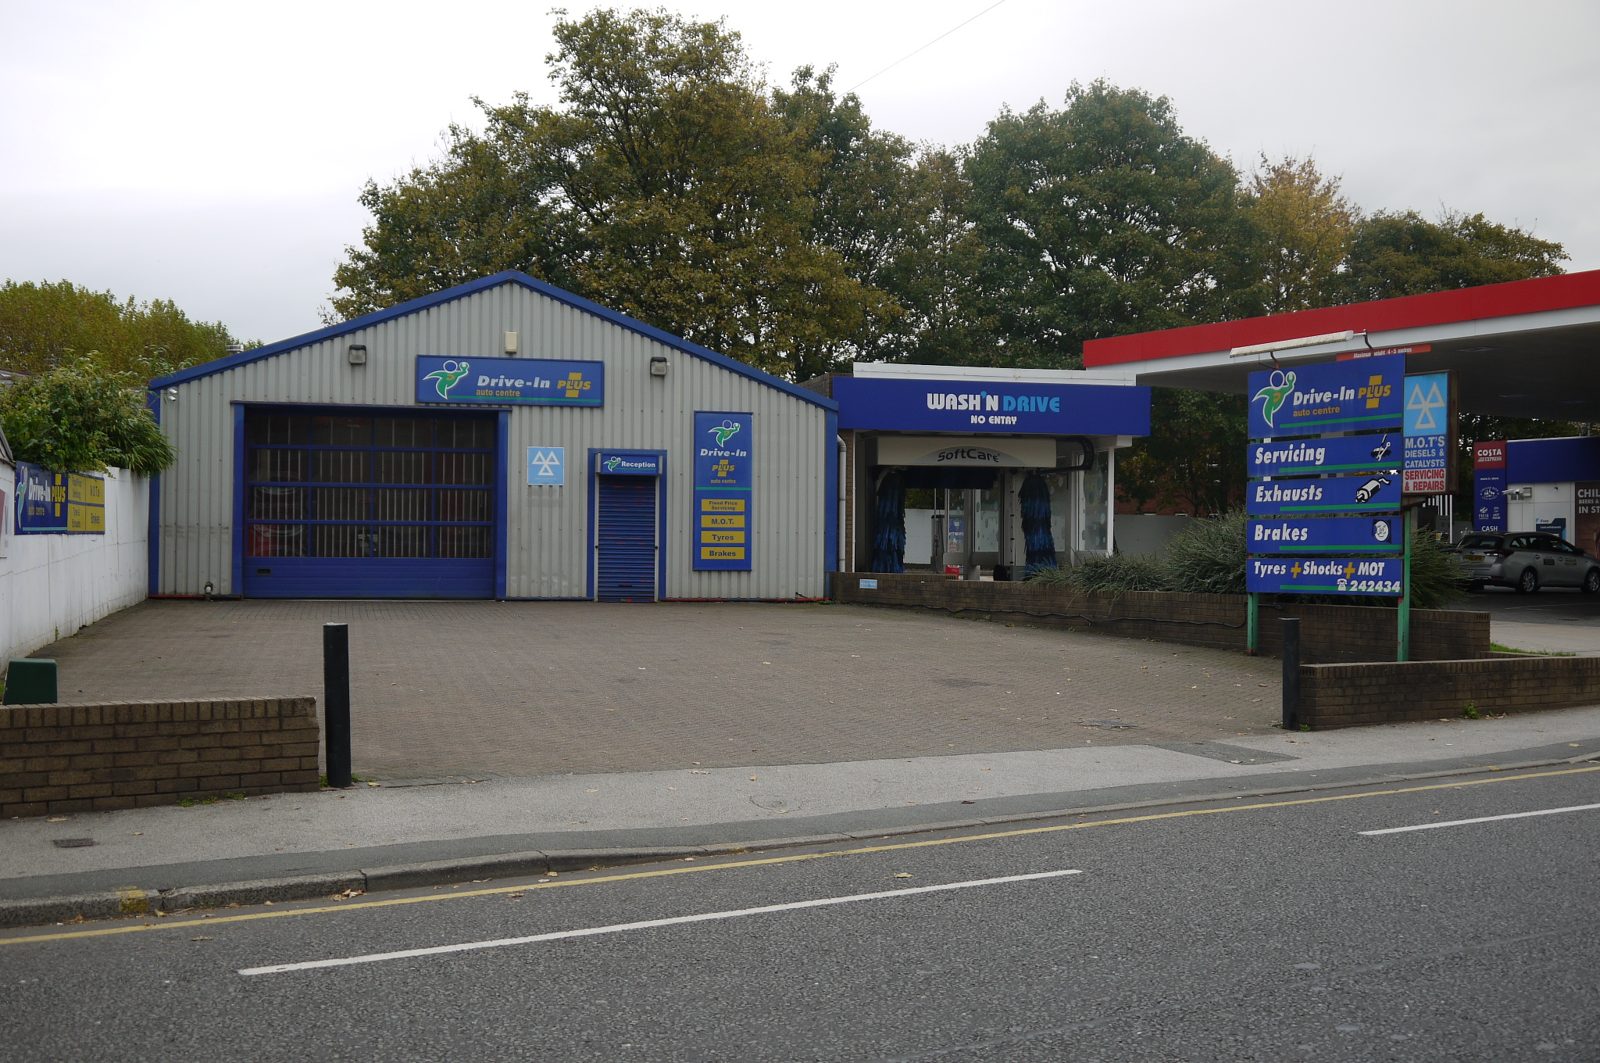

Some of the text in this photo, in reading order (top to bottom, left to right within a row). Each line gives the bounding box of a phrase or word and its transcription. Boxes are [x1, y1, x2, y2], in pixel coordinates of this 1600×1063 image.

[477, 375, 592, 391] Drive-In PLUS
[476, 388, 520, 397] auto centre
[1293, 384, 1391, 406] Drive-In PLUS
[926, 390, 1060, 413] WASH'N DRIVE
[1293, 405, 1340, 418] auto centre
[970, 414, 1018, 426] NO ENTRY
[1404, 436, 1445, 449] M.O.T'S
[700, 448, 747, 457] Drive-In
[1255, 443, 1326, 465] Servicing
[1404, 448, 1444, 458] DIESELS &
[1477, 448, 1502, 457] COSTA
[621, 460, 656, 469] Reception
[1404, 459, 1445, 468] CATALYSTS
[1404, 469, 1445, 480] SERVICING
[1404, 480, 1445, 491] & REPAIRS
[1255, 484, 1323, 502] Exhausts
[1579, 506, 1589, 514] IN
[711, 534, 735, 542] Tyres
[1254, 523, 1308, 541] Brakes
[1254, 561, 1287, 578] Tyres
[1302, 560, 1343, 576] Shocks
[1357, 562, 1385, 576] MOT
[1349, 580, 1401, 593] 242434
